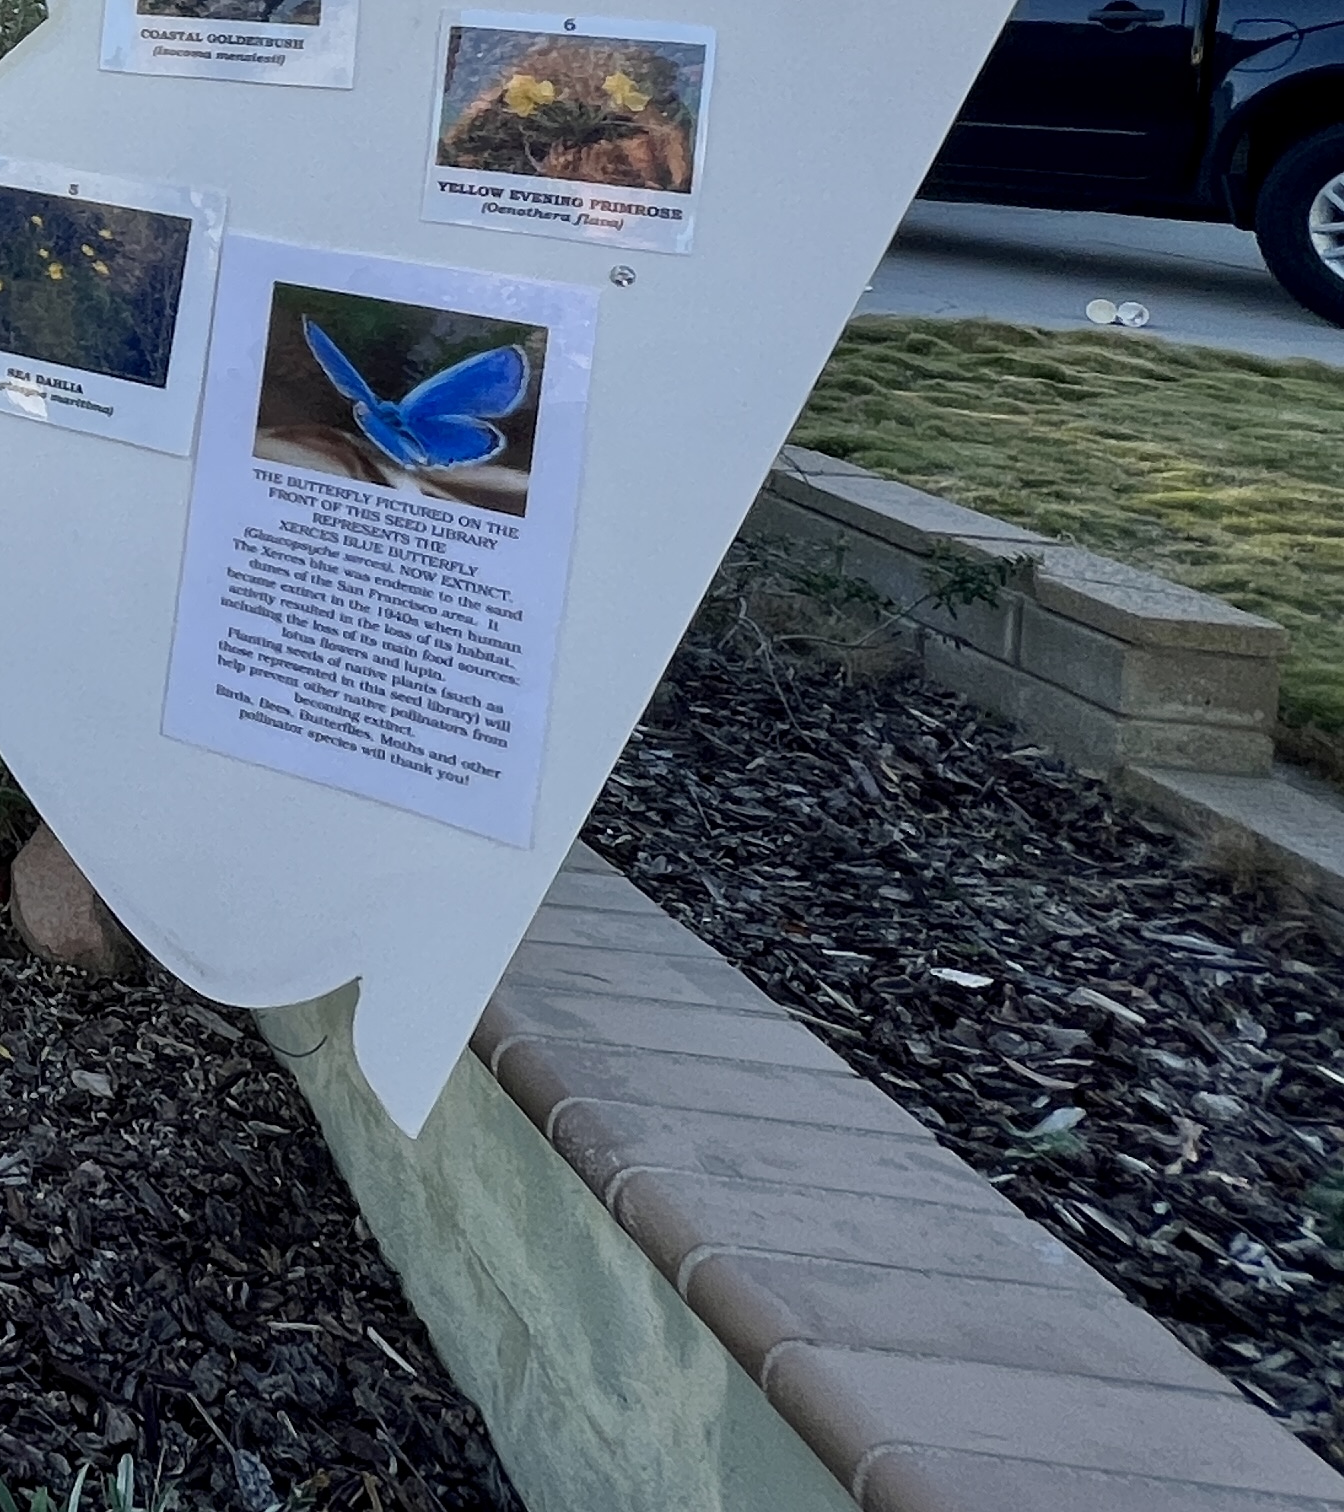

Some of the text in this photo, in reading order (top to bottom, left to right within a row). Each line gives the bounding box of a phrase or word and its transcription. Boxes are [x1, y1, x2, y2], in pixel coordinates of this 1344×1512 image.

[141, 28, 304, 49] COASTAL GOLDENBUSH
[564, 17, 576, 31] 6
[68, 183, 79, 195] 5
[437, 181, 683, 221] YELLOW EVENING PRIMROSE
[7, 368, 30, 381] SEA
[36, 374, 83, 394] DAHLIA
[253, 468, 520, 539] THE BUTTERFLY PICTURED ON THE
[269, 487, 498, 550] FRONT OF THIS SEED LIBRARY
[279, 520, 479, 577] XERCES BLUE BUTTERFLY
[313, 512, 446, 553] REPRESENTS THE
[233, 538, 258, 553] The
[310, 557, 339, 573] blue
[344, 568, 370, 582] was
[439, 591, 453, 603] to
[458, 596, 481, 610] the
[485, 604, 523, 621] sand
[294, 570, 307, 581] of
[311, 574, 332, 587] the
[337, 580, 364, 596] San
[369, 588, 438, 614] Francisco
[400, 565, 513, 603] NOW EXTINCT.
[390, 753, 433, 775] thank
[436, 769, 469, 785] you!
